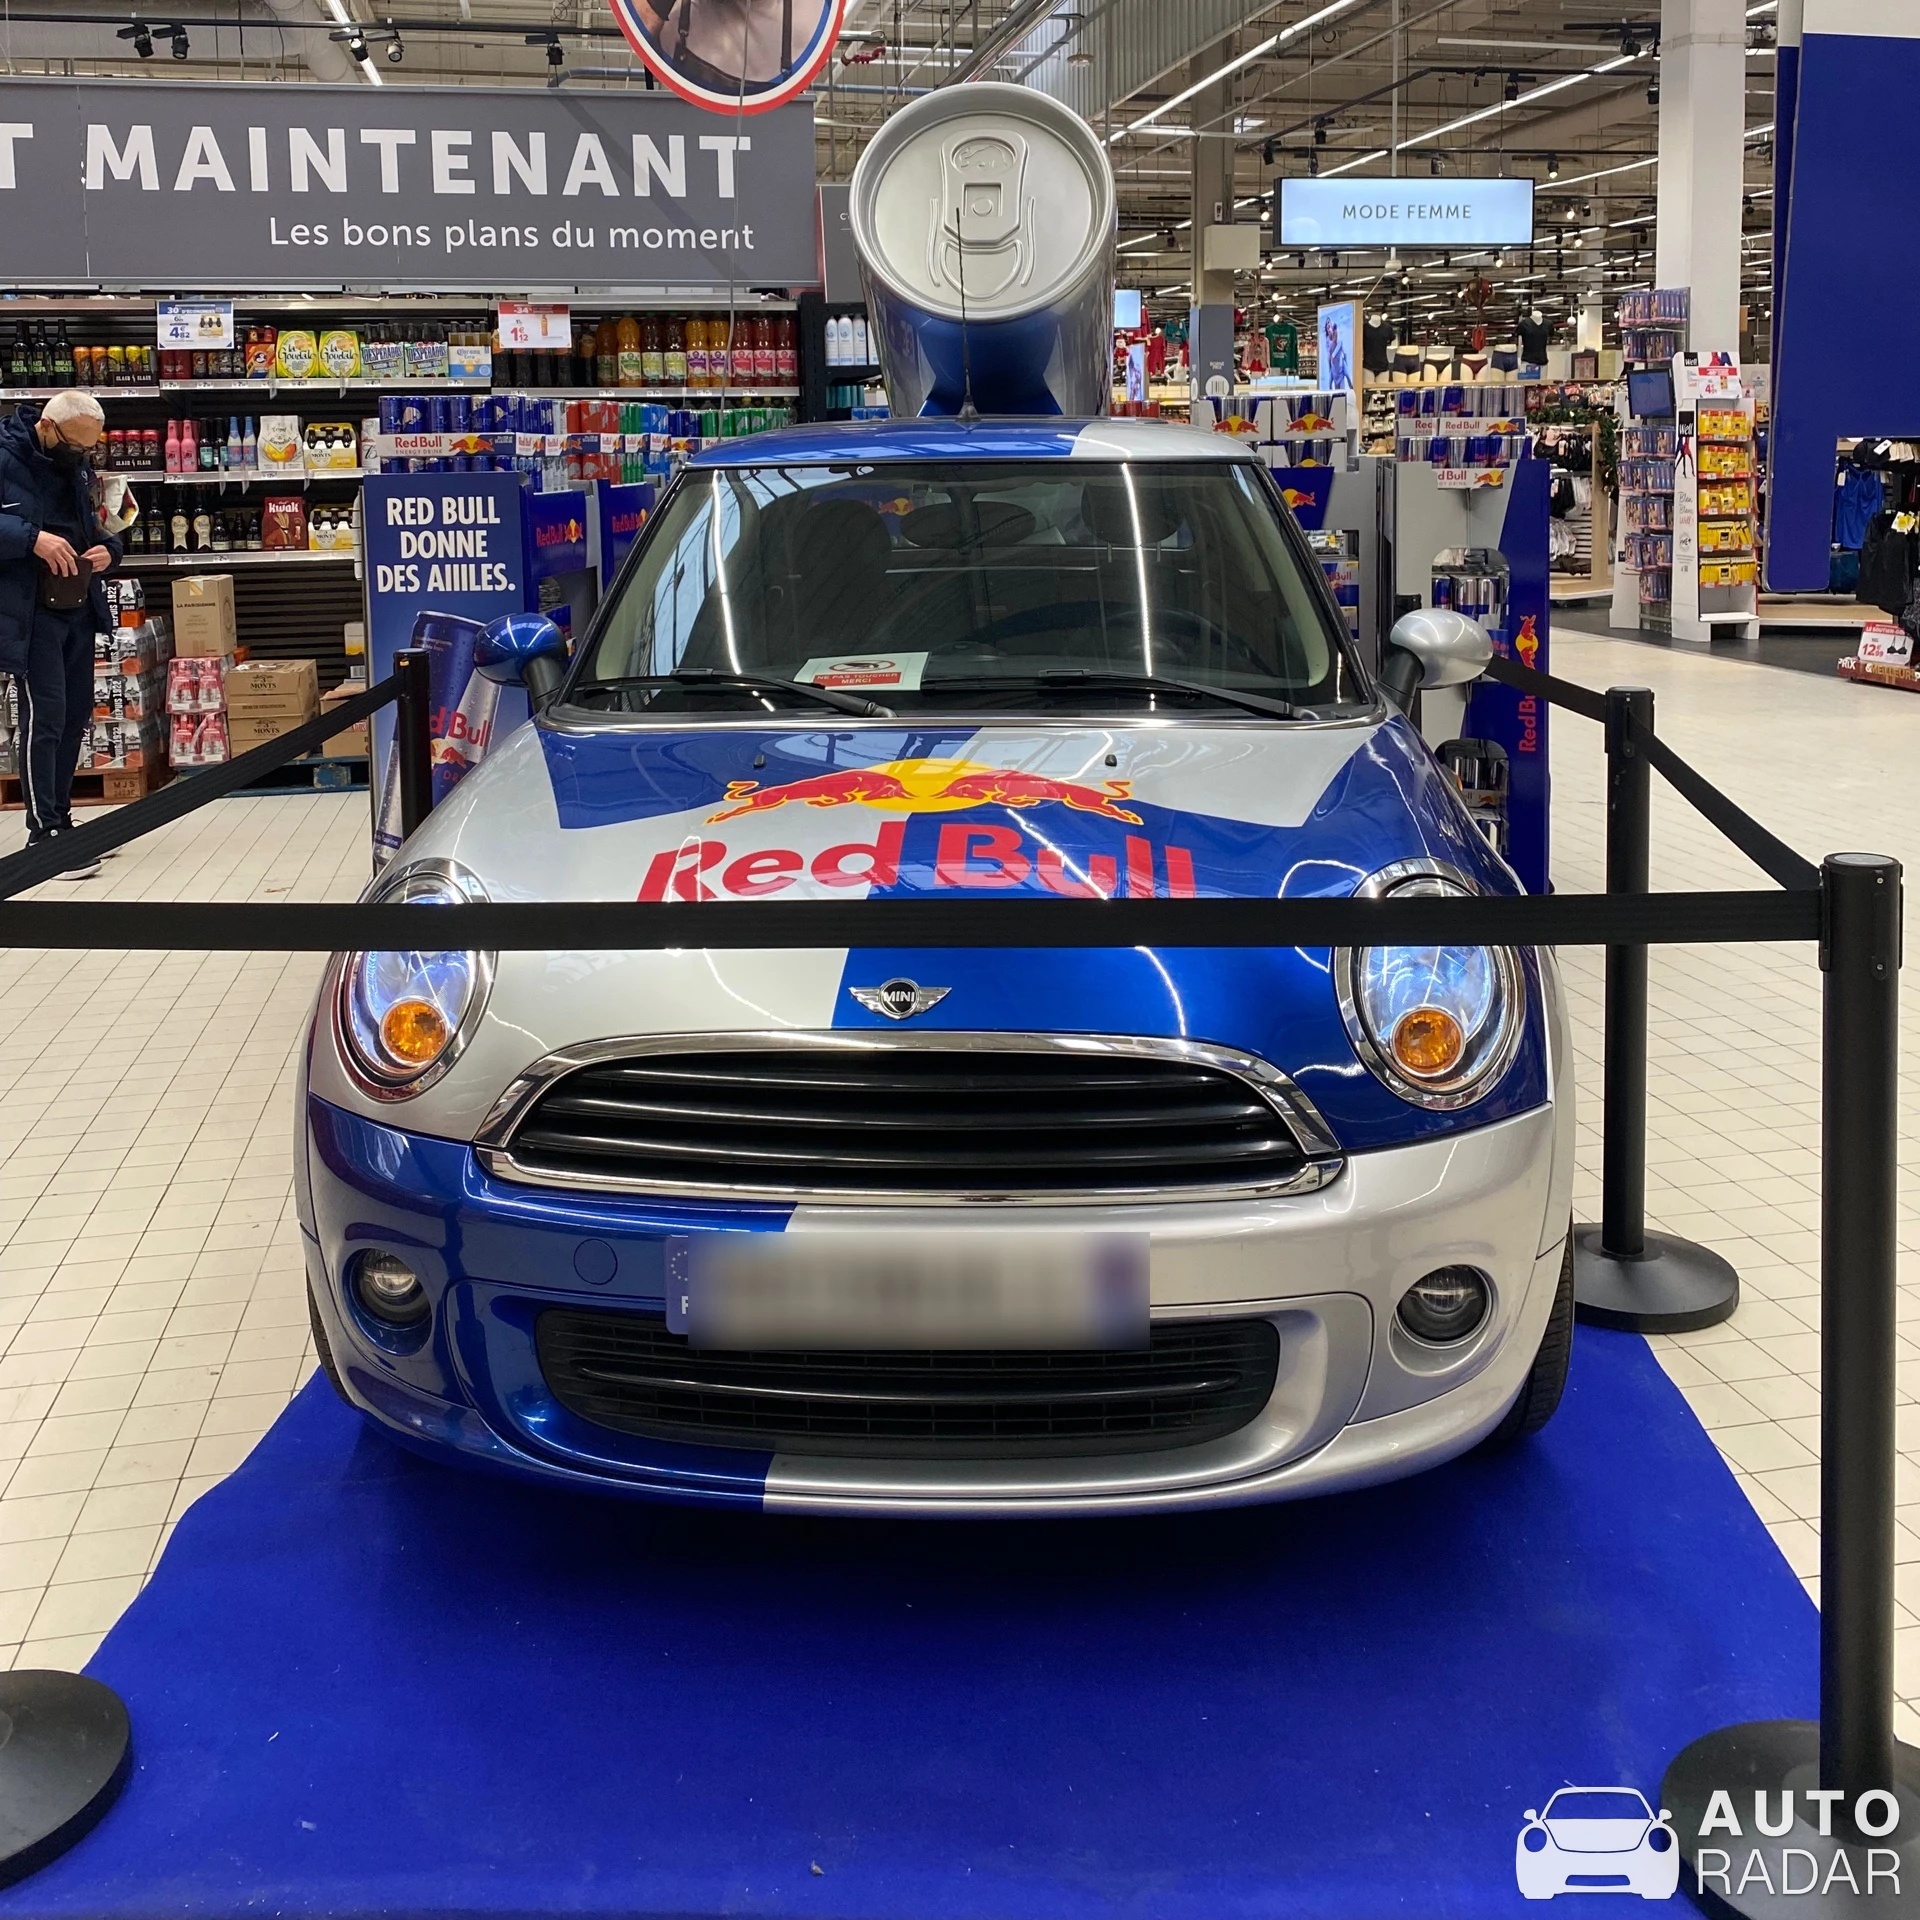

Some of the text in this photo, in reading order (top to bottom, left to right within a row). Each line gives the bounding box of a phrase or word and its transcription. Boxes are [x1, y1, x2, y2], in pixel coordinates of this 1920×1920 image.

[85, 124, 752, 198] MAINTENANT
[1342, 204, 1472, 219] MODE FEMME
[270, 217, 755, 253] Les bons plans du moment
[407, 345, 448, 362] DESPERADOS
[1446, 421, 1480, 429] Red Bull
[1679, 423, 1694, 436] Well
[395, 435, 442, 448] Red Bull
[1446, 470, 1467, 480] Bull
[268, 501, 299, 514] kwak
[386, 496, 501, 526] RED BULL
[536, 523, 563, 547] Red Bull
[400, 530, 488, 559] DONNE
[377, 563, 516, 593] DES AIIILES.
[107, 586, 117, 604] 1922
[1837, 657, 1856, 670] PRIX
[1865, 663, 1873, 673] &
[112, 680, 122, 698] 1922
[448, 711, 491, 749] Bull
[1518, 715, 1537, 751] Red
[636, 820, 1197, 902] Red Bull
[883, 990, 915, 1002] MINI
